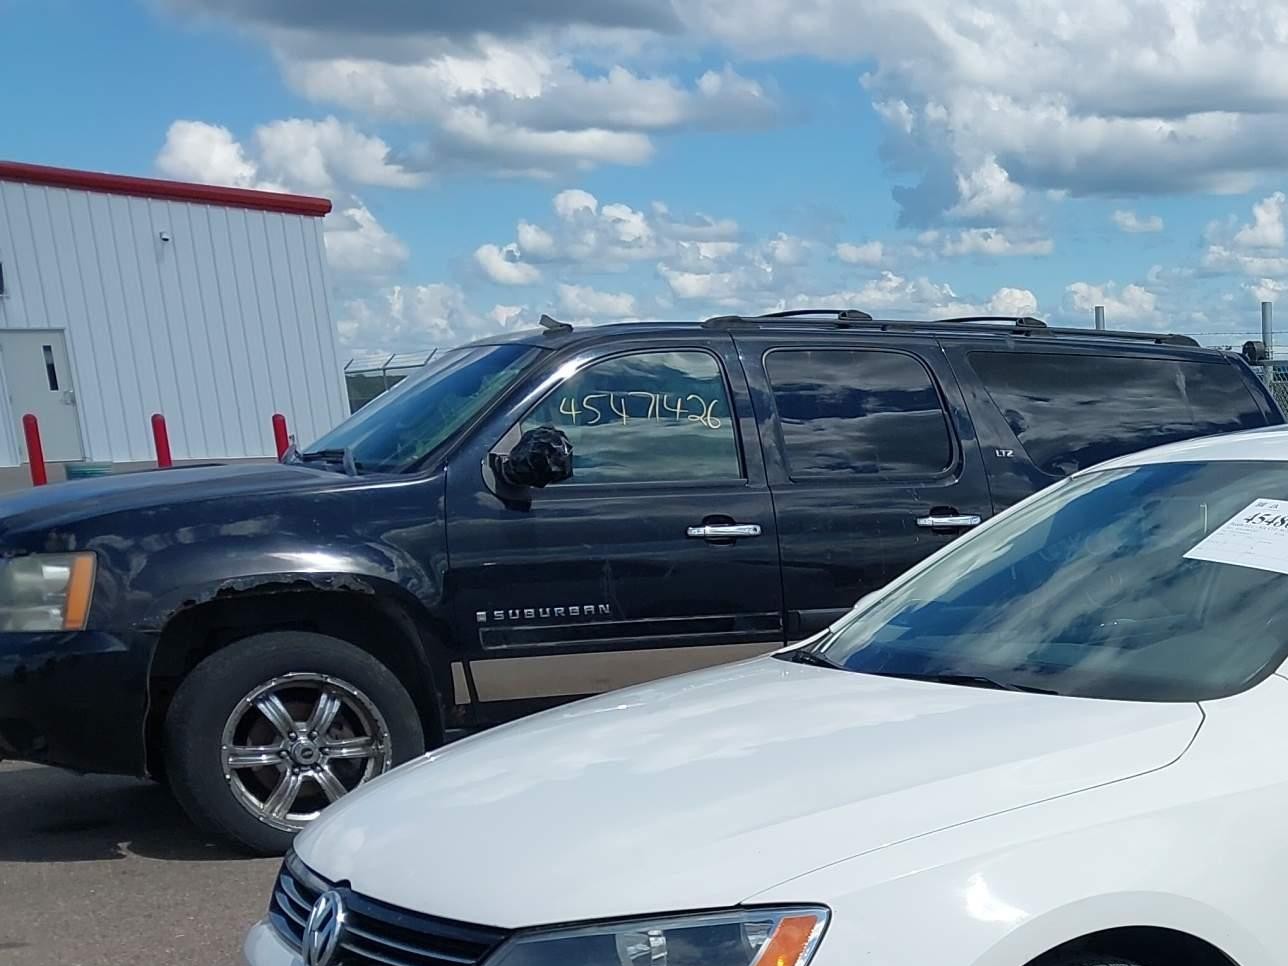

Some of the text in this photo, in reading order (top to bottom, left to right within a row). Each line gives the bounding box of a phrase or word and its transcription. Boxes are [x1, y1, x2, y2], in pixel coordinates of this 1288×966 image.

[559, 391, 722, 429] 45471426
[995, 449, 1015, 458] LTZ
[493, 603, 611, 621] SUBURBAN
